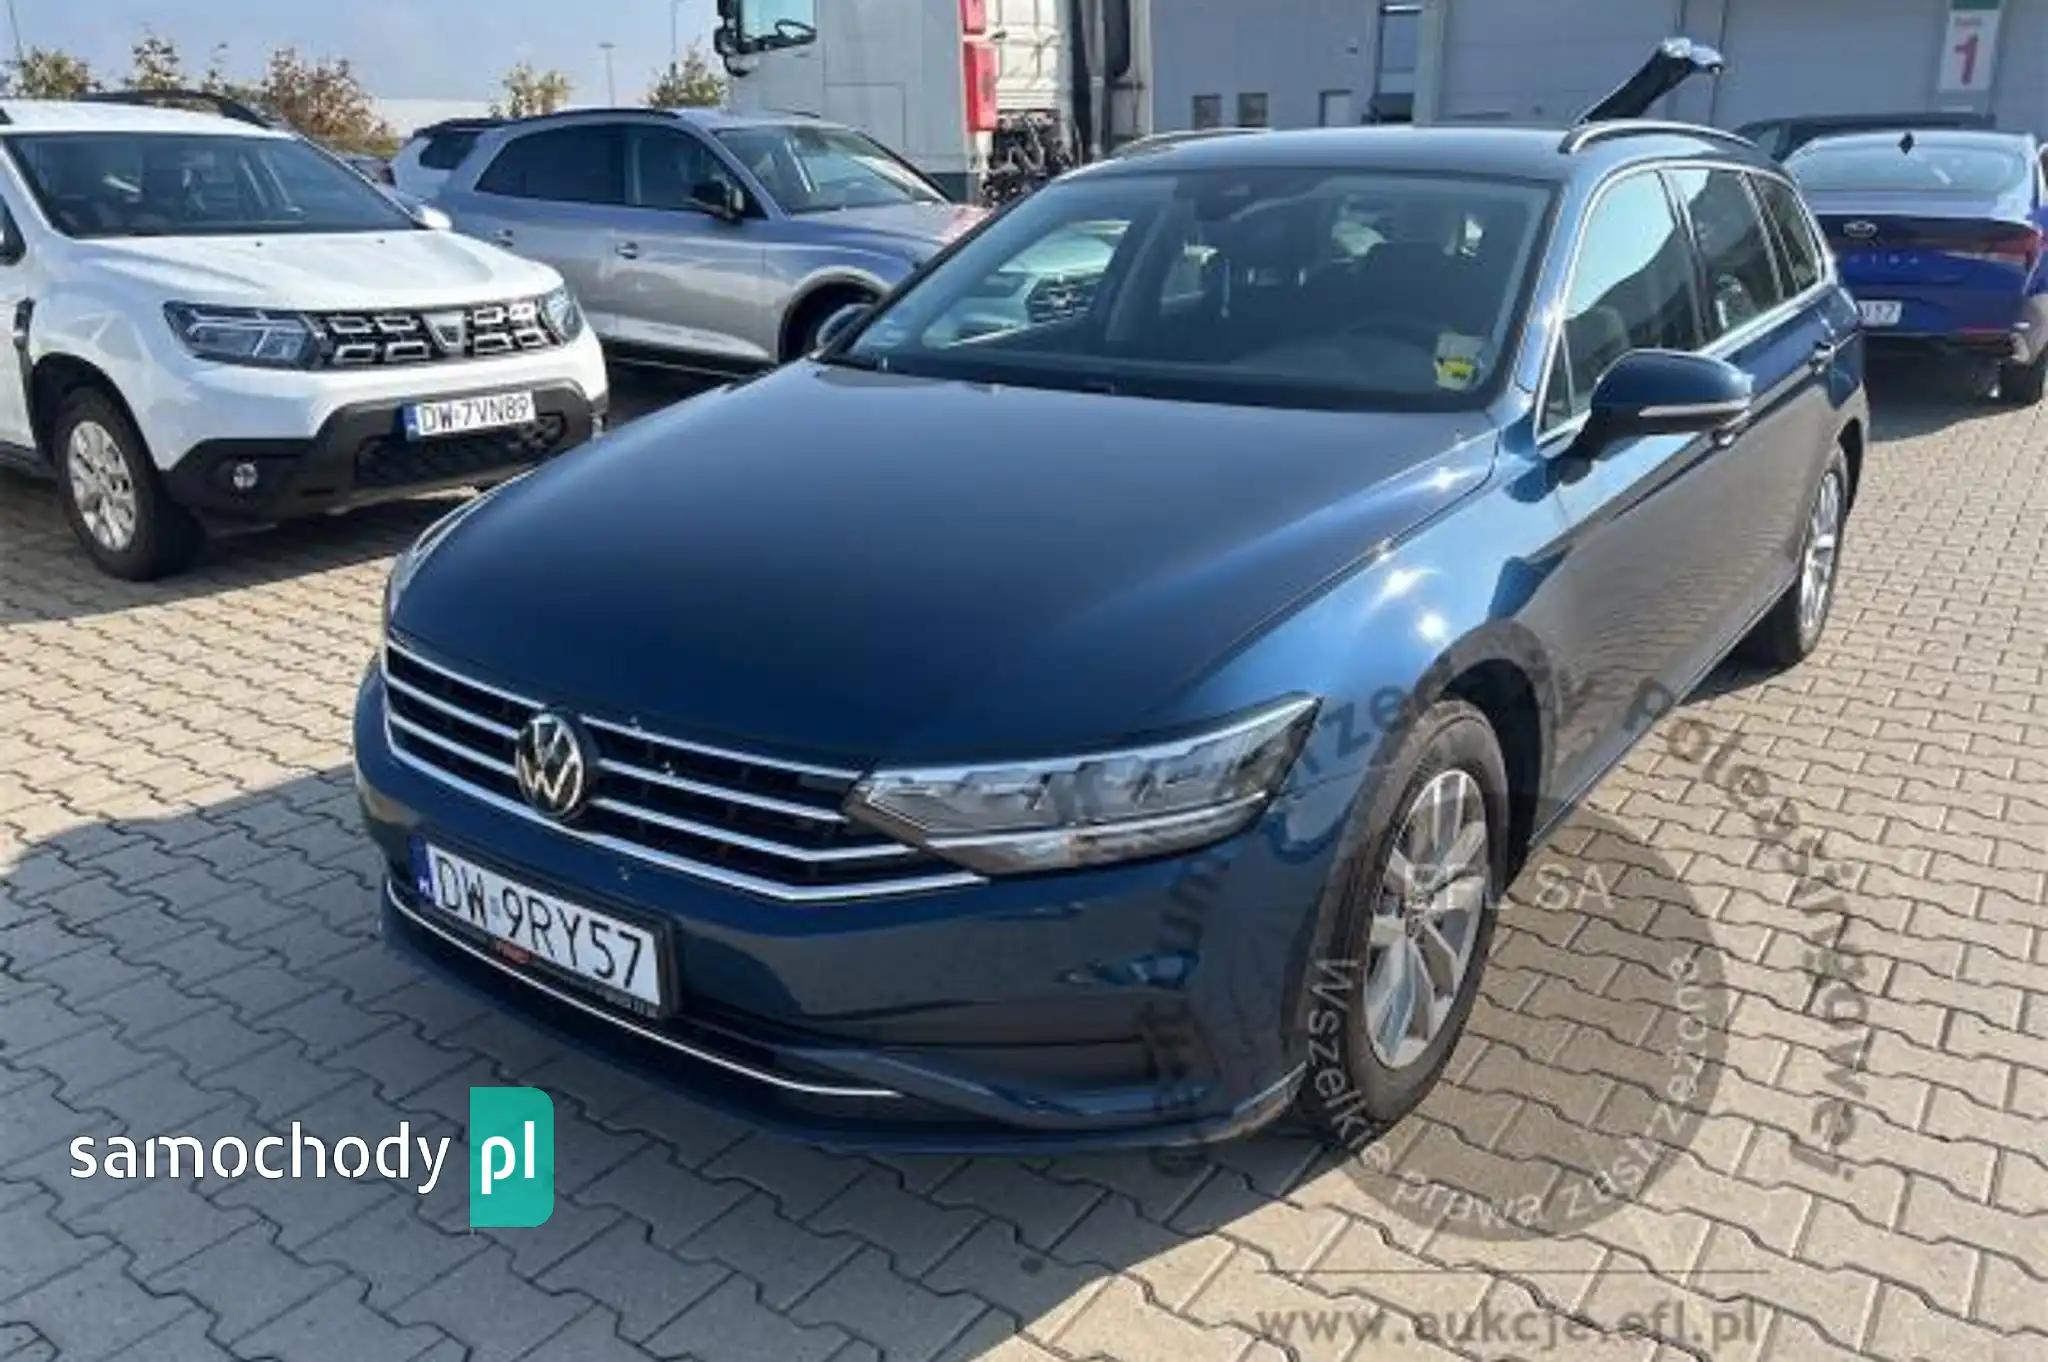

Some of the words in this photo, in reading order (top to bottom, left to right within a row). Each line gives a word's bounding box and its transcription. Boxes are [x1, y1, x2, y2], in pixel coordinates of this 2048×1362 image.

[1954, 33, 1979, 86] 1
[423, 402, 453, 432] DW
[460, 396, 529, 426] 7VN89
[436, 855, 488, 928] DW
[502, 888, 643, 988] 9RY57
